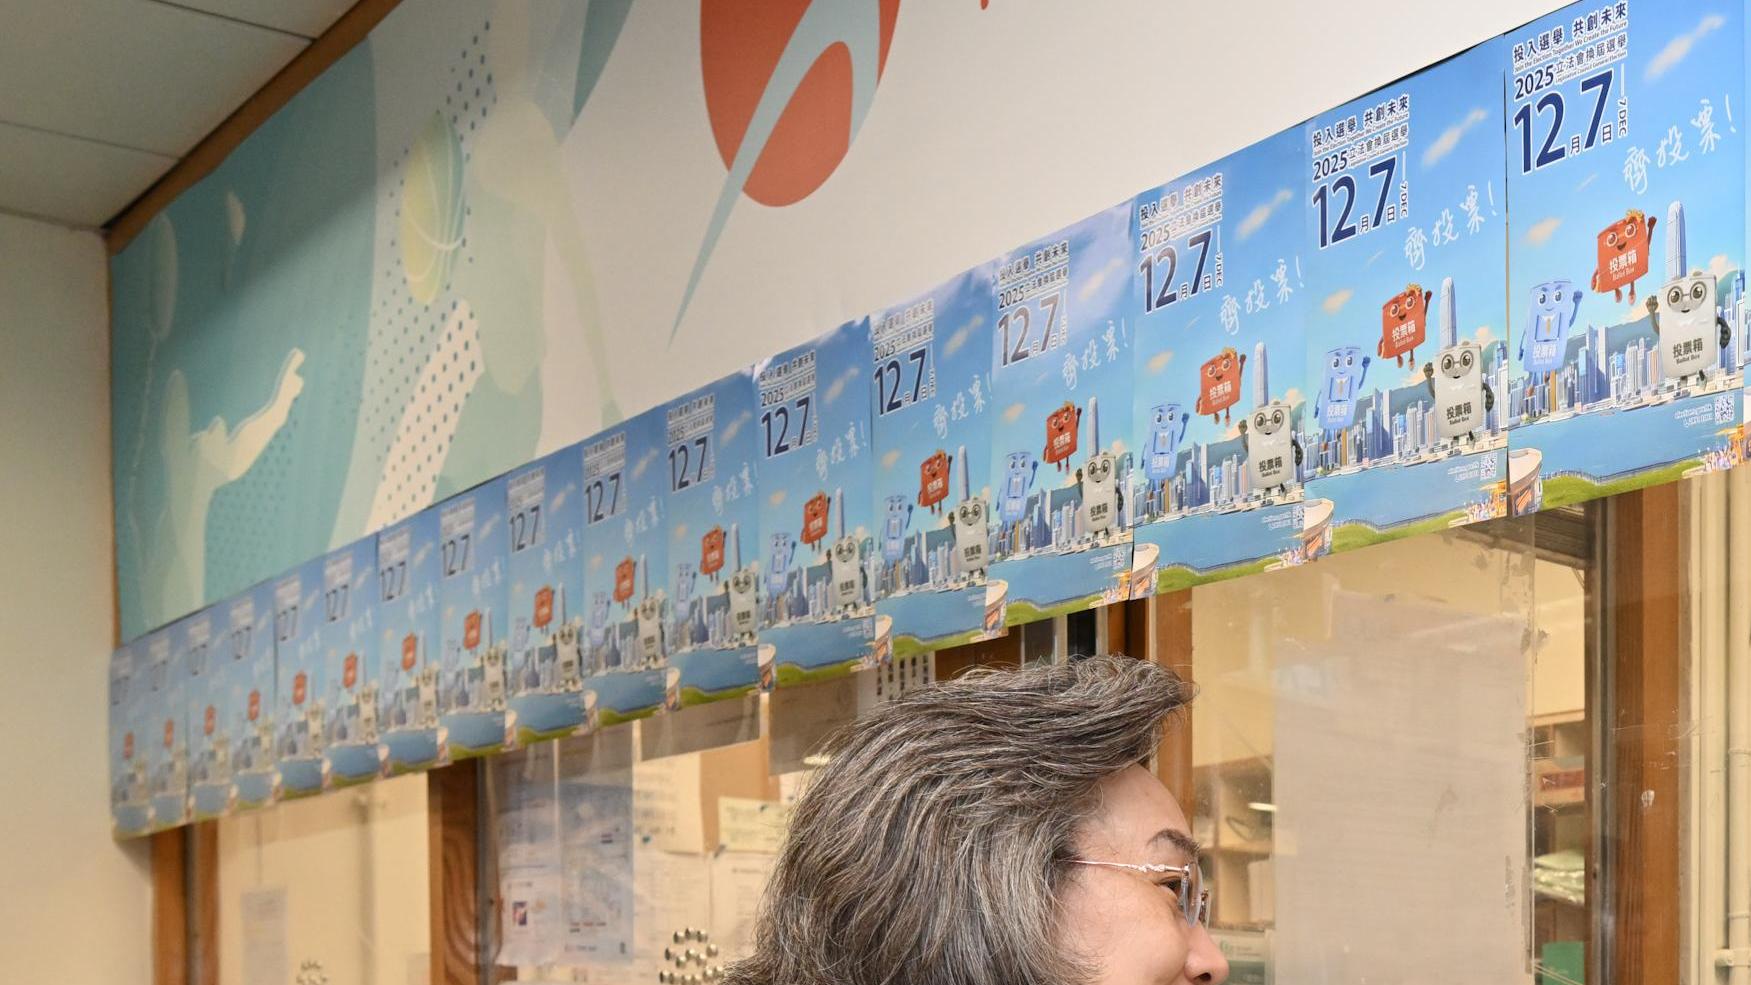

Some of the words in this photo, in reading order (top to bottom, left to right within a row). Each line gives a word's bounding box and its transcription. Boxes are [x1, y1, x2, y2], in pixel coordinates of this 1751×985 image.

[1514, 28, 1563, 63] 投入選舉
[1573, 3, 1627, 37] 共創未來
[1584, 32, 1599, 43] Create
[1515, 65, 1554, 99] 2025
[1556, 34, 1626, 73] 立法會換屆選舉
[1313, 117, 1355, 148] 投入選舉
[1364, 97, 1408, 126] 共創未來
[1514, 70, 1613, 173] 12月7日
[1314, 151, 1347, 181] 2025
[1349, 125, 1408, 158] 立法會換屆選舉
[1313, 157, 1396, 248] 12月7日
[1141, 224, 1169, 251] 2025
[1141, 230, 1211, 313] 12月7日
[1609, 250, 1637, 273] 投票箱
[999, 285, 1023, 309] 2025
[1392, 320, 1415, 341] 投票箱
[1673, 338, 1703, 358] 投票箱
[1676, 356, 1687, 365] Ballot
[1689, 354, 1699, 362] Box
[1210, 381, 1231, 399] 投票箱
[1446, 402, 1471, 419] 投票箱
[1259, 456, 1282, 472] 投票箱
